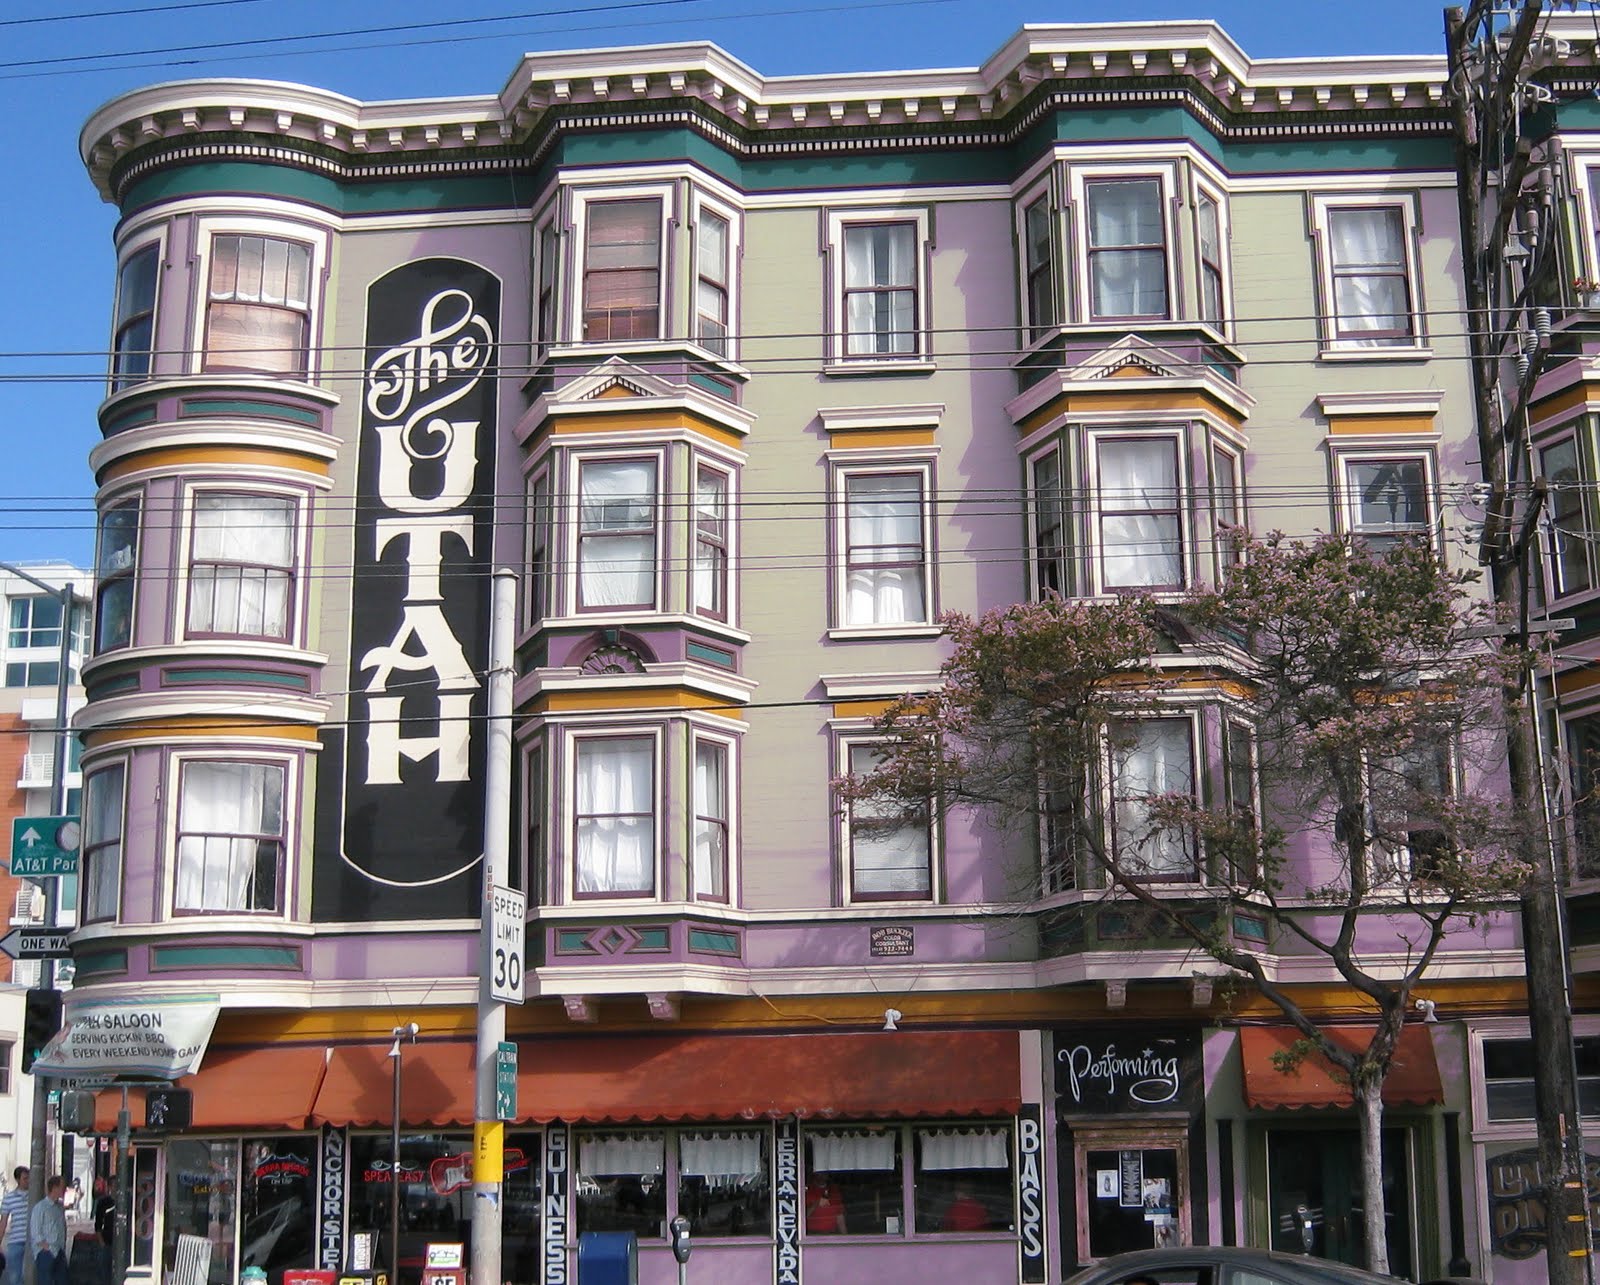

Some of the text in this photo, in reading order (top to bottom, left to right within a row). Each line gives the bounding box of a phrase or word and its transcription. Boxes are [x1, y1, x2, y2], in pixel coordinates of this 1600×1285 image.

[367, 289, 493, 458] The
[361, 422, 481, 785] UTAH
[14, 857, 76, 872] AT&T Par
[494, 895, 524, 919] SPEED
[21, 937, 70, 950] ONE WA
[496, 922, 520, 943] LIMIT
[494, 948, 520, 991] 30
[103, 1013, 162, 1029] SALOON
[72, 1033, 108, 1044] SERVING
[145, 1033, 165, 1044] BBQ
[72, 1048, 101, 1059] EVERY
[103, 1047, 151, 1058] WEEKEND
[1058, 1044, 1178, 1103] Performing
[323, 1129, 344, 1215] ANCHOR
[364, 1170, 424, 1182] SPEAEASY
[1020, 1119, 1042, 1257] BASS
[547, 1128, 566, 1285] GUINESS
[778, 1200, 798, 1283] NEVADA
